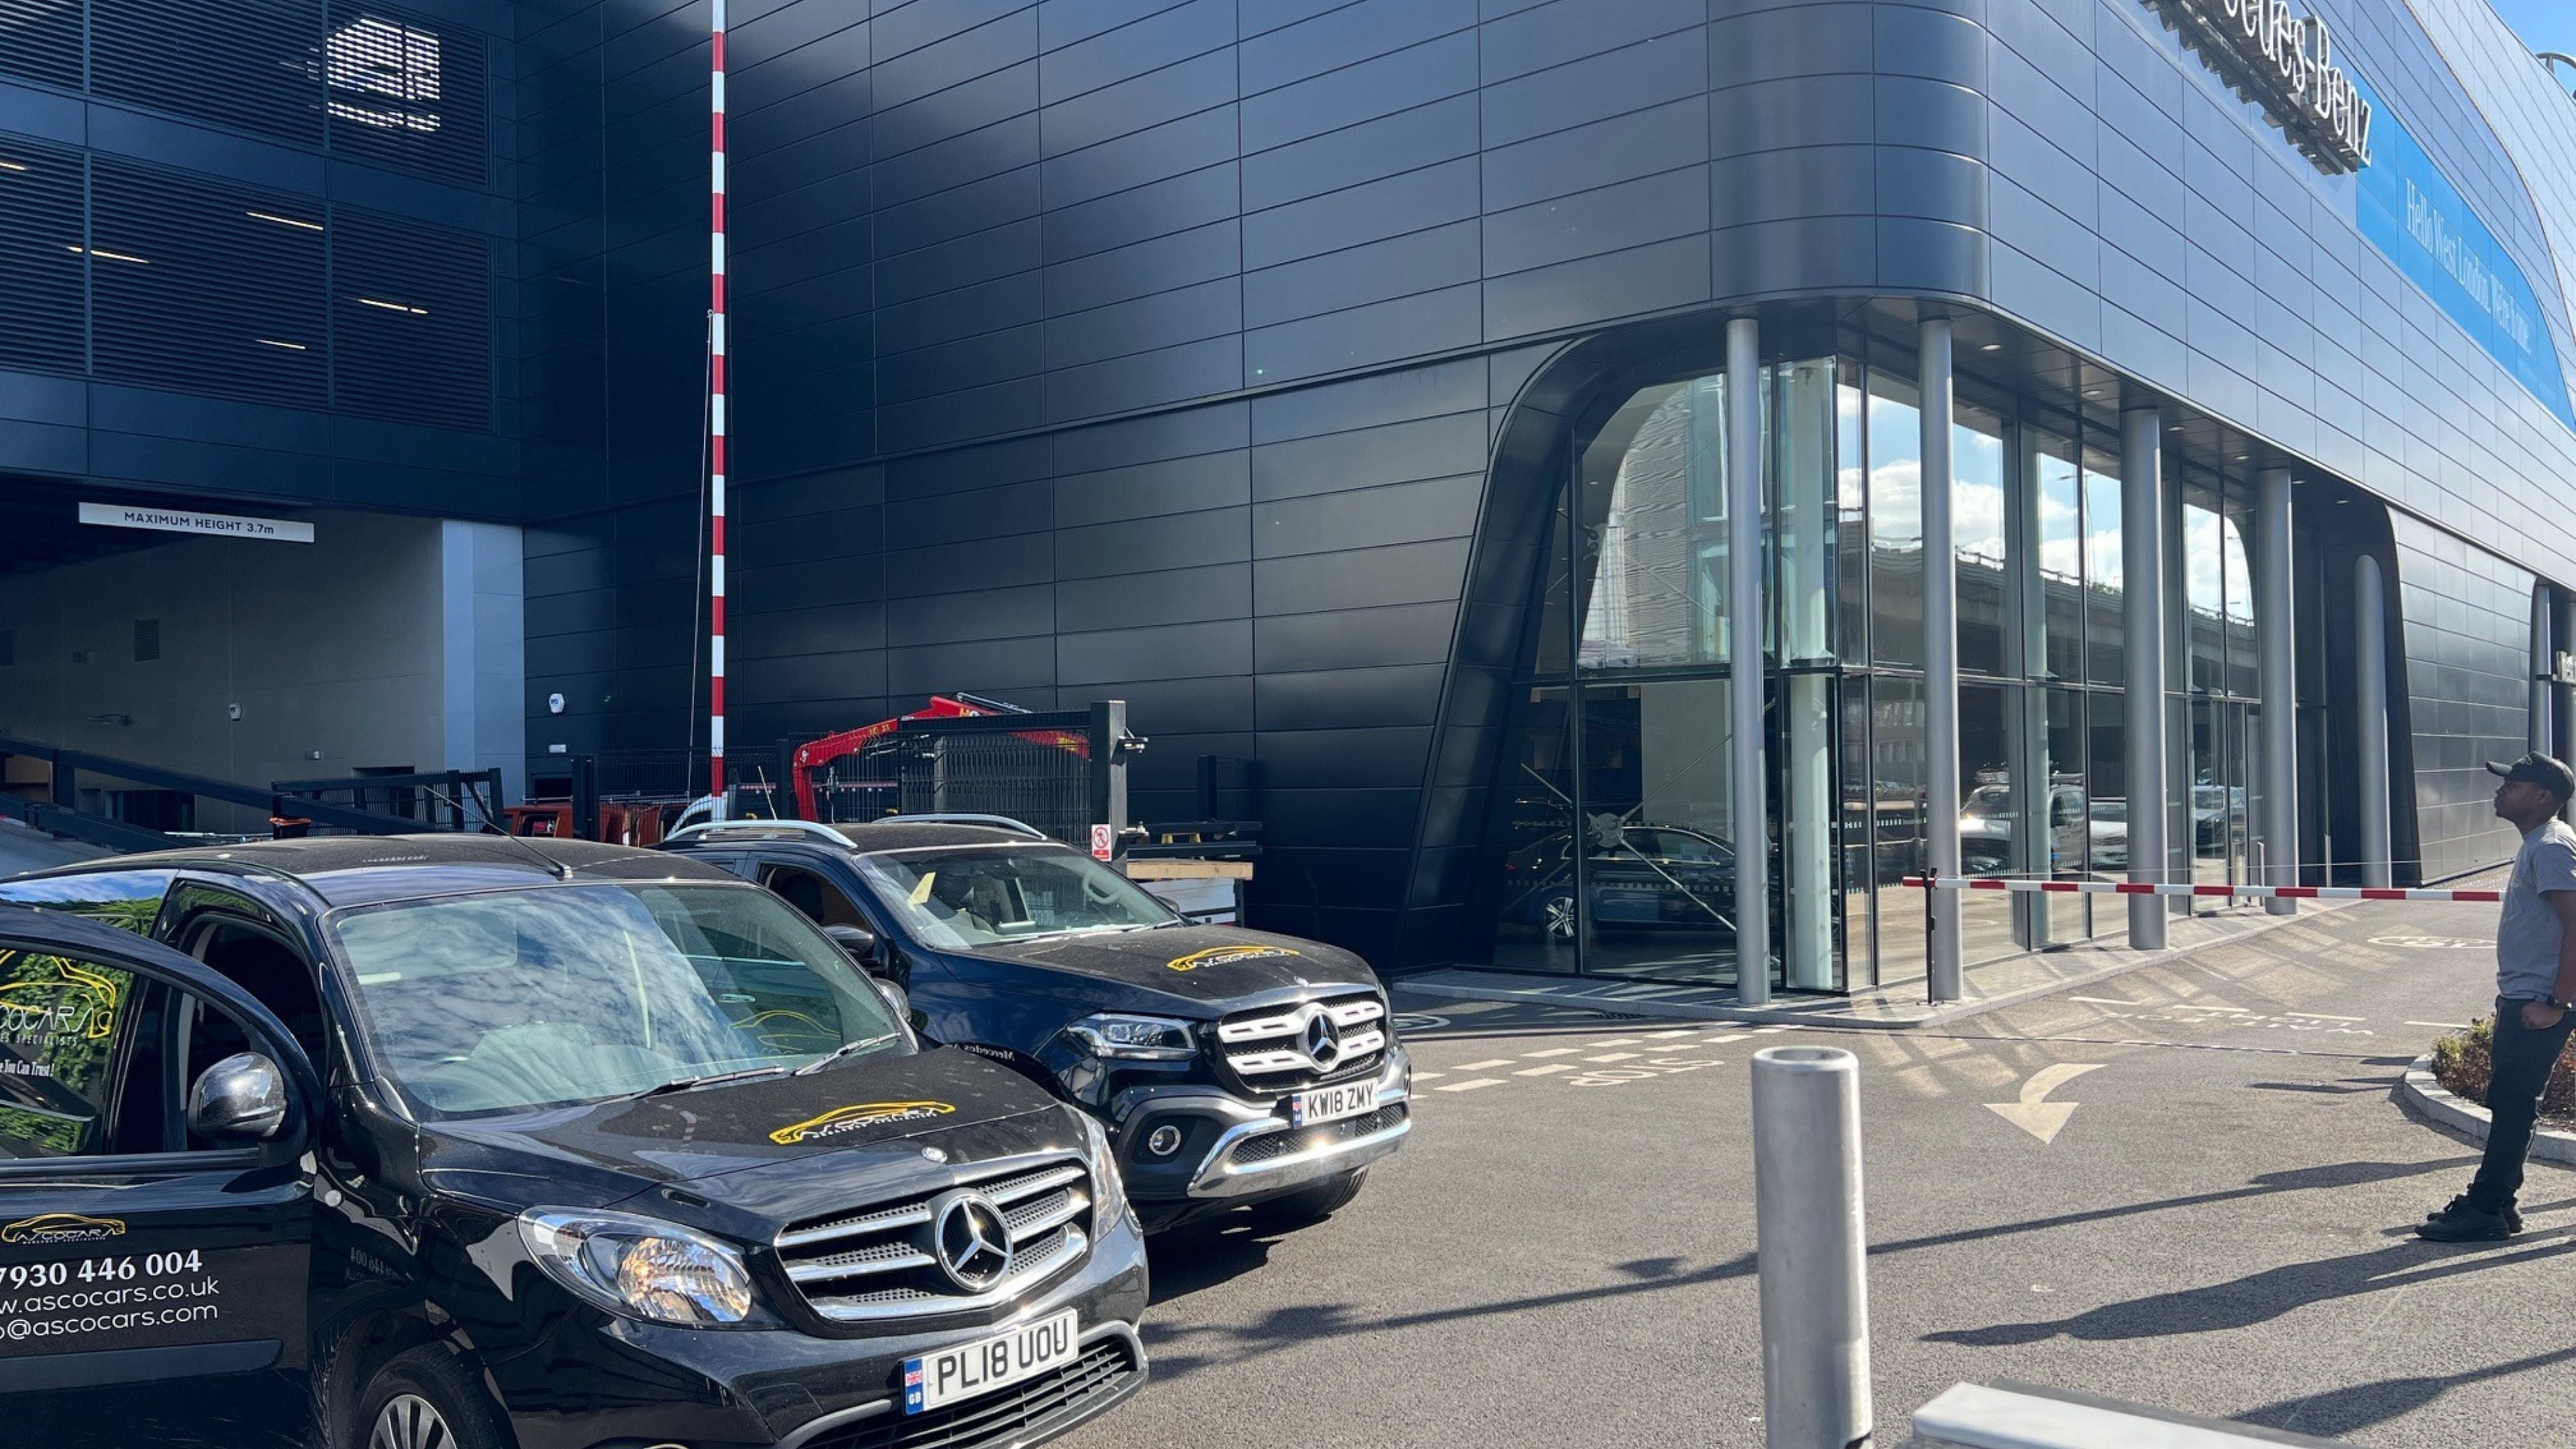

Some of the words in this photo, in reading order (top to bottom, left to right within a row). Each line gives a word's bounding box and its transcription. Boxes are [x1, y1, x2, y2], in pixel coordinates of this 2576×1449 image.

[2224, 0, 2371, 166] des-Benz
[2406, 177, 2434, 255] Hello
[2433, 208, 2456, 279] West
[2457, 235, 2491, 314] London.
[124, 512, 190, 527] MAXIMUM
[195, 518, 242, 531] HEIGHT
[247, 523, 274, 535] 3.7m
[2231, 1021, 2374, 1035] WAIT
[17, 1060, 30, 1075] Can
[1561, 1057, 1725, 1087] STOP
[1308, 1090, 1342, 1118] KW18
[1347, 1083, 1373, 1110] ZMY
[77, 1256, 136, 1283] 446
[146, 1249, 203, 1276] 004
[938, 1340, 1008, 1395] PL18
[1018, 1318, 1068, 1369] UOU
[908, 1391, 921, 1405] GB
